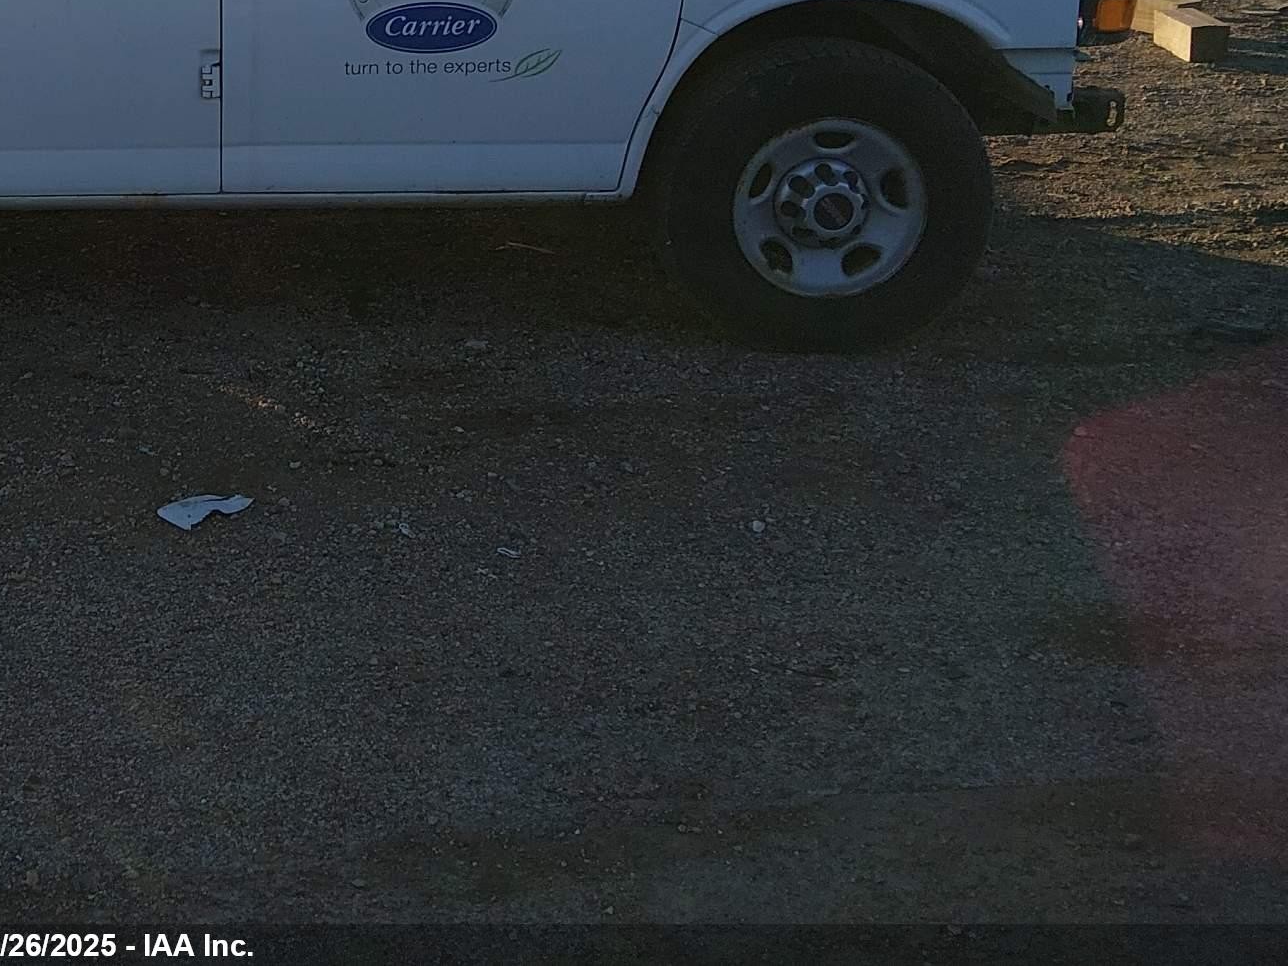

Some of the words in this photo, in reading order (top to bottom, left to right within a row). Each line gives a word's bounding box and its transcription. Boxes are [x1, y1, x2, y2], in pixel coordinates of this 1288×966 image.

[385, 16, 481, 36] Carrier
[344, 61, 380, 75] turn
[387, 61, 403, 74] to
[410, 60, 437, 74] the
[444, 58, 511, 76] experts
